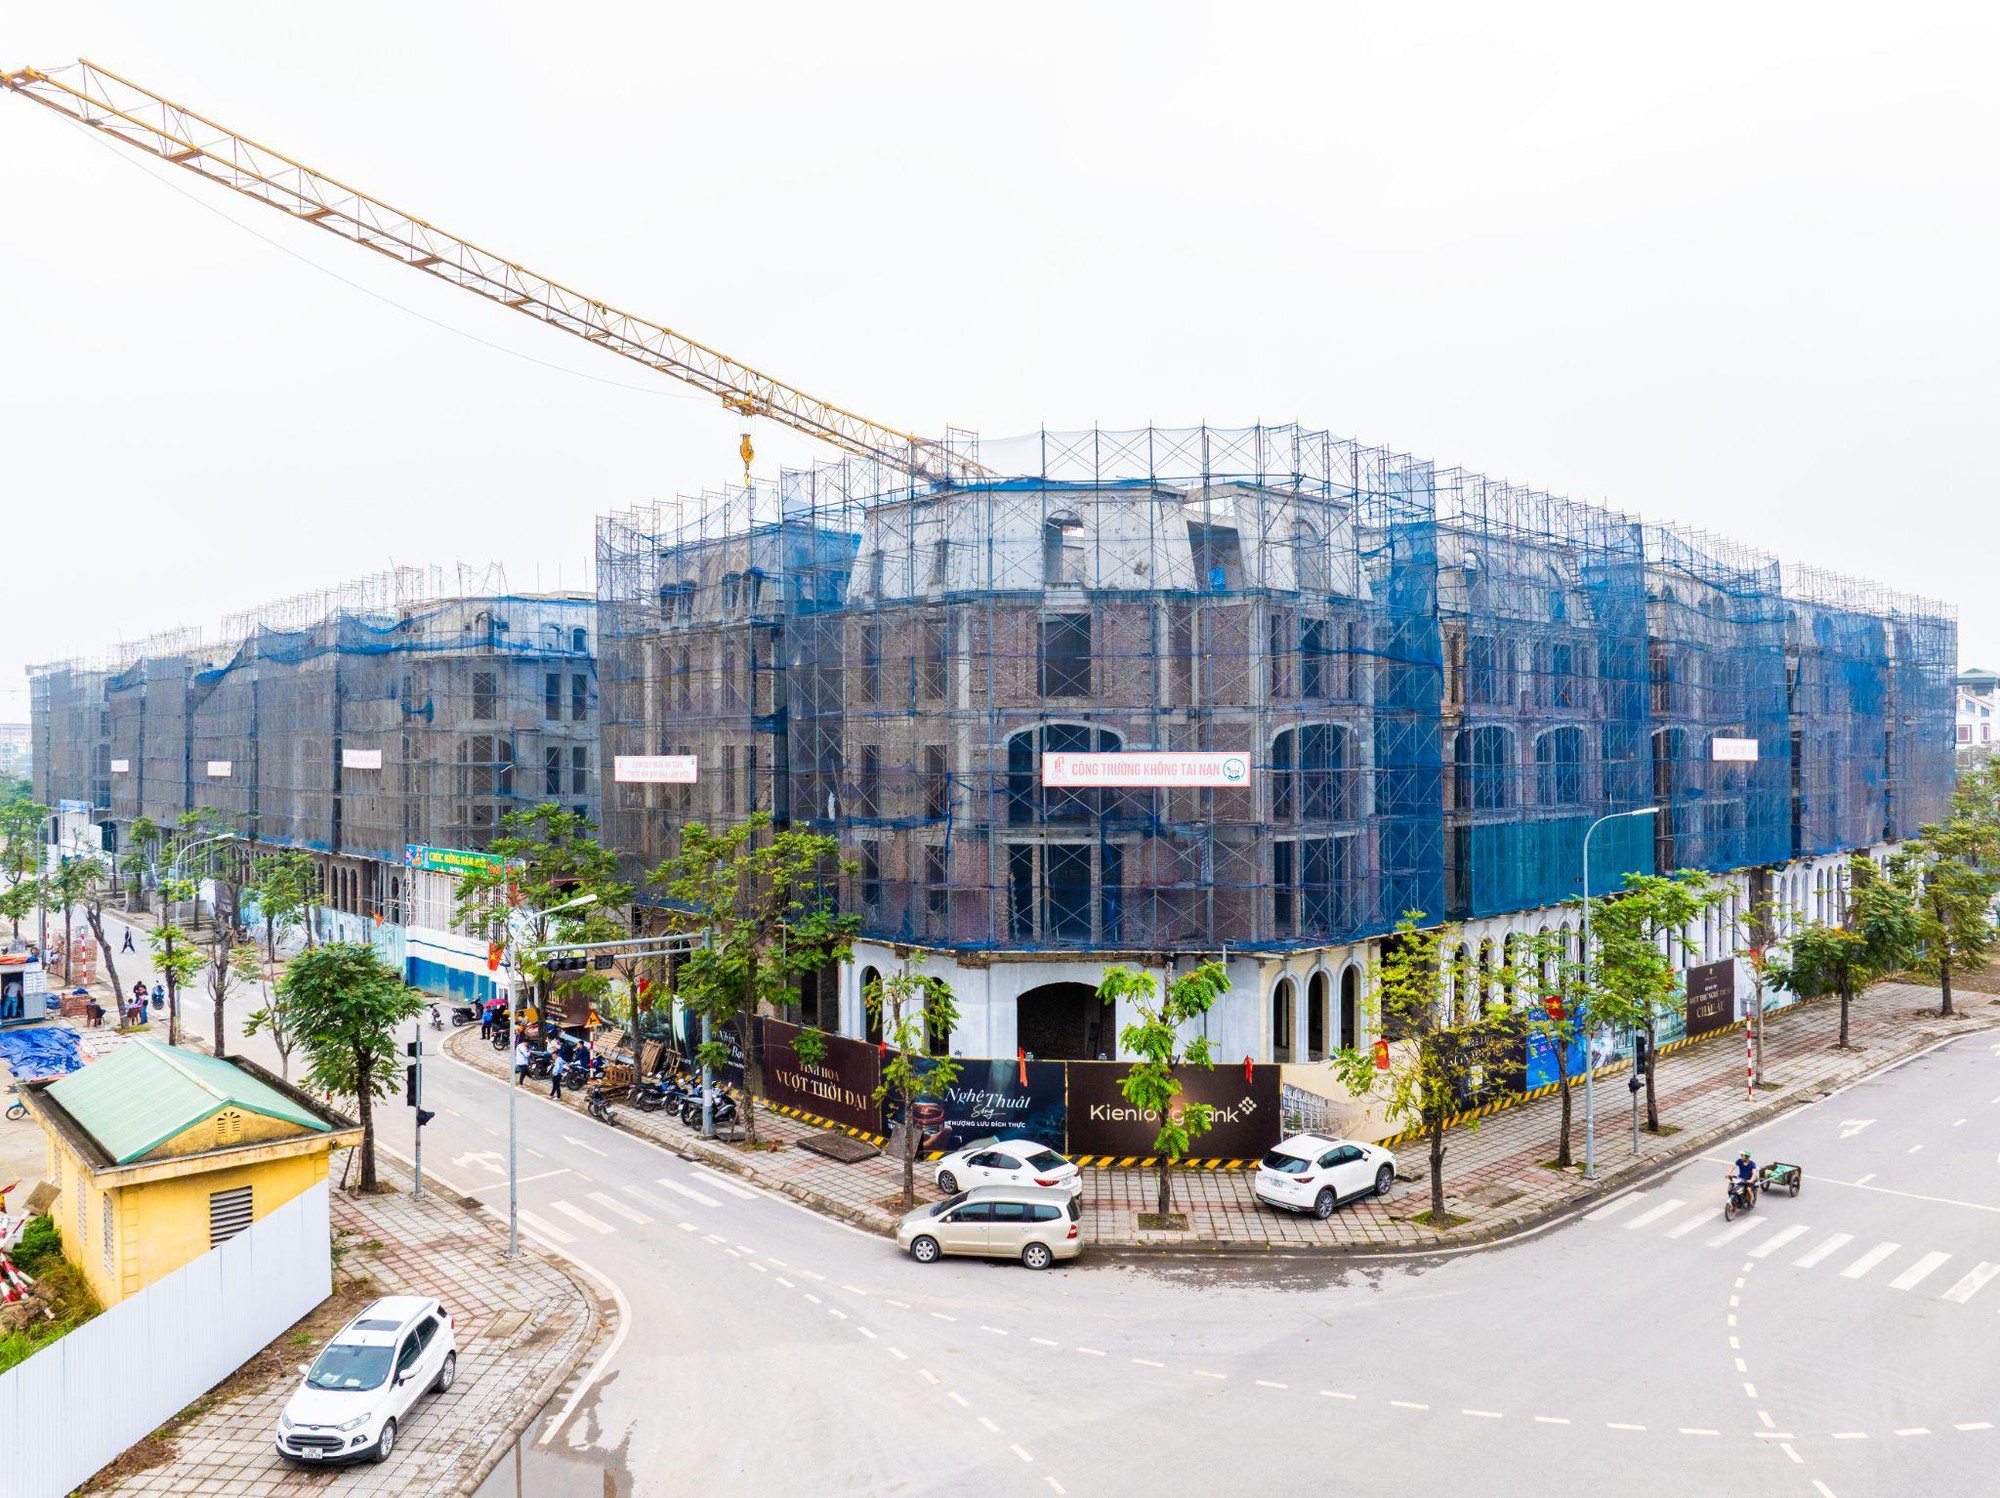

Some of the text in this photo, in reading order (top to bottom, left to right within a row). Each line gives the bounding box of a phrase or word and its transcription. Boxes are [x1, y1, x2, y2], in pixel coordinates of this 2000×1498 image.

[1072, 761, 1098, 775] CÔNG
[1144, 761, 1178, 775] KHÔNG
[775, 1069, 867, 1111] VƯỢT THỜI ĐẠI
